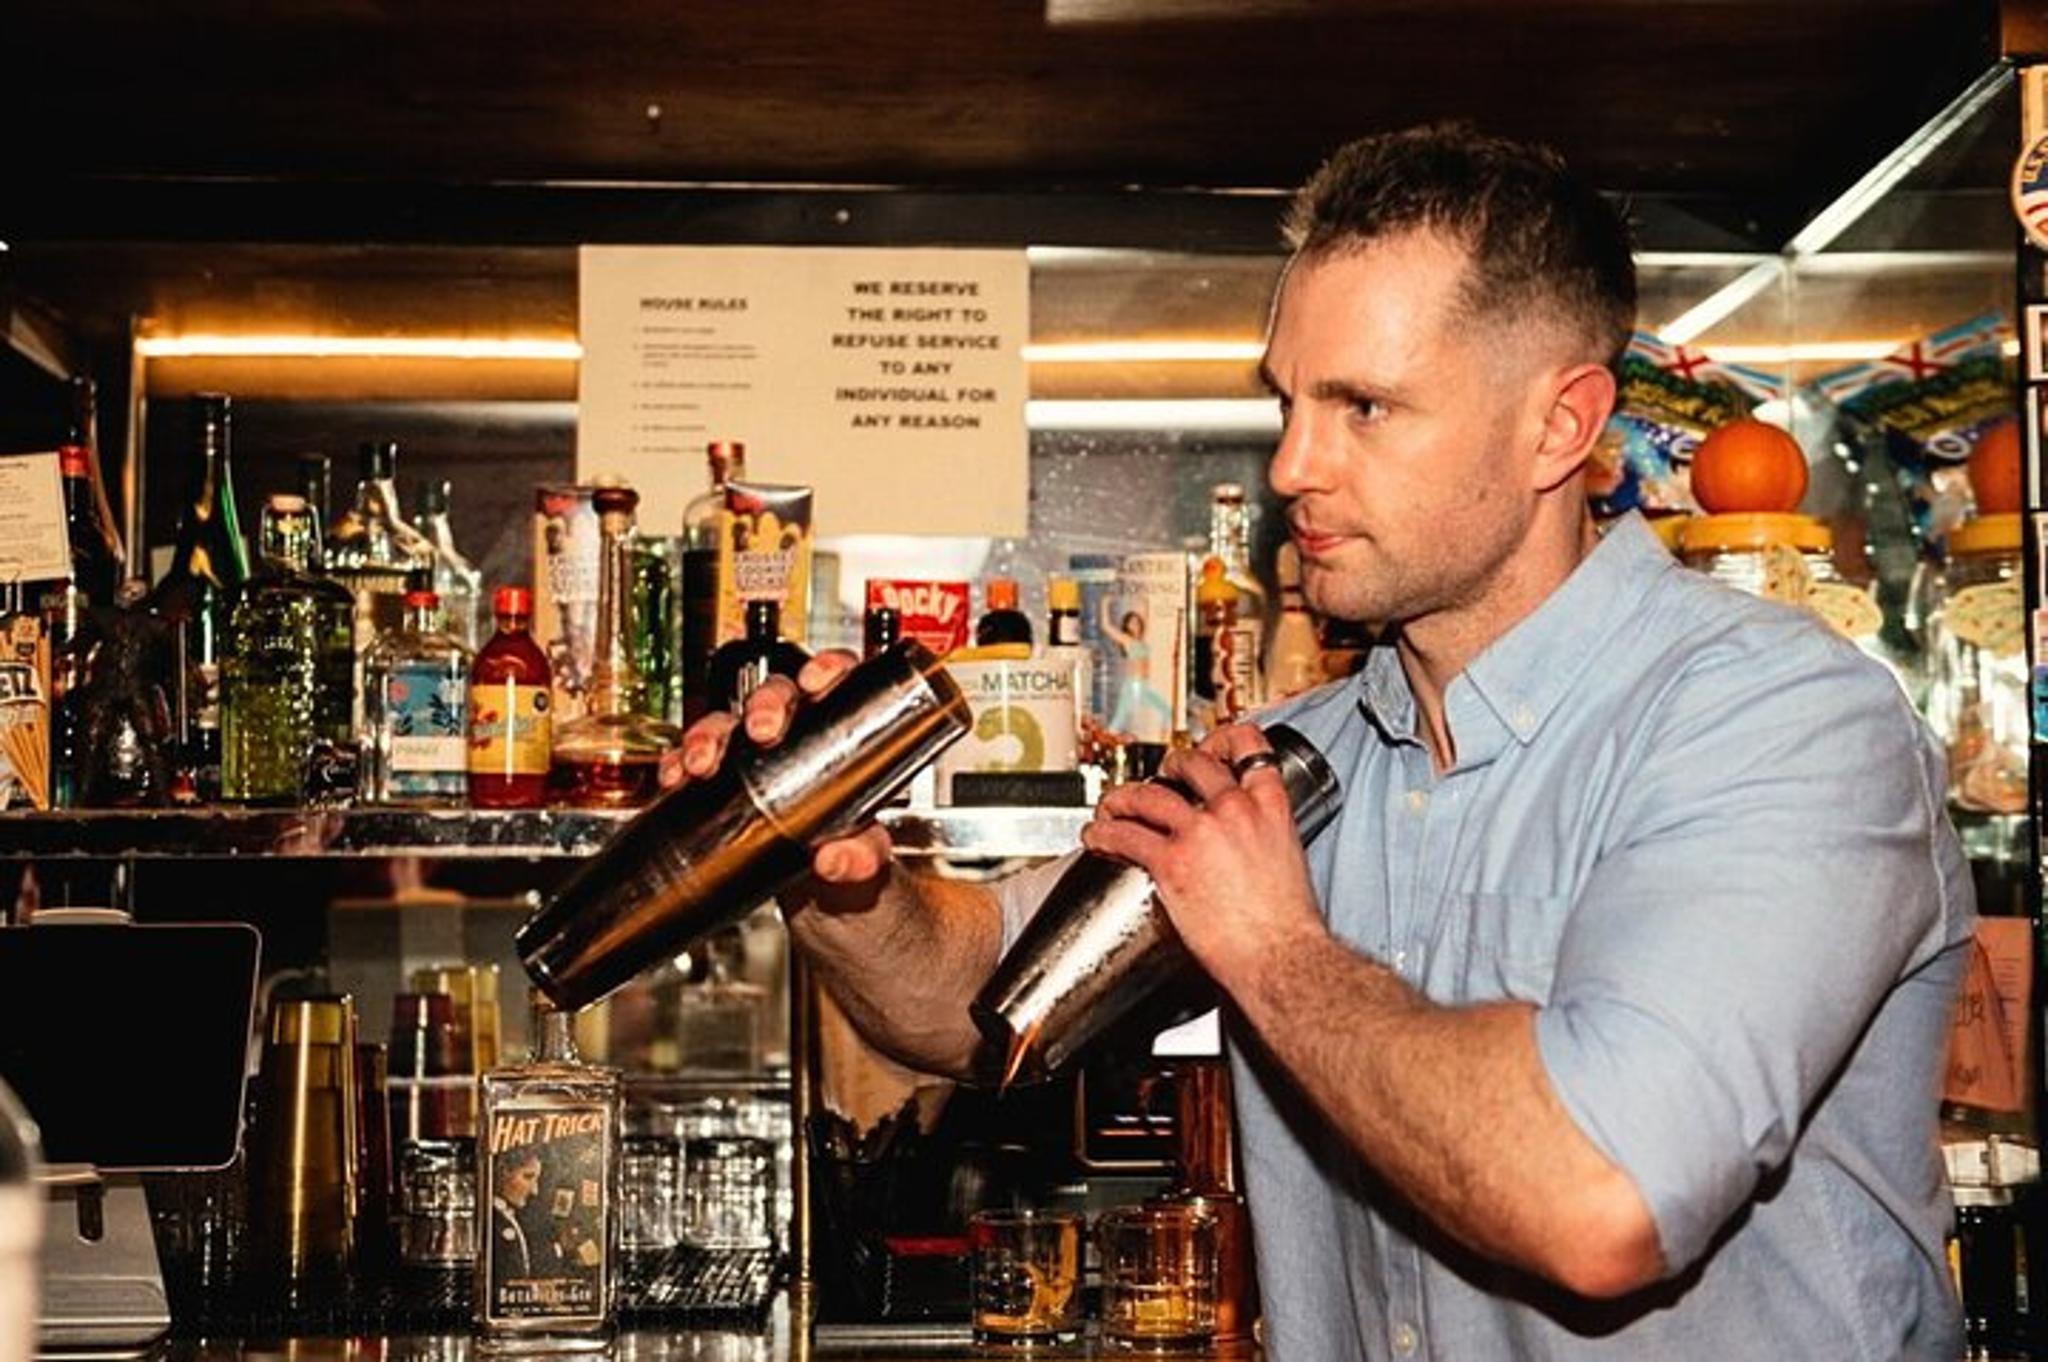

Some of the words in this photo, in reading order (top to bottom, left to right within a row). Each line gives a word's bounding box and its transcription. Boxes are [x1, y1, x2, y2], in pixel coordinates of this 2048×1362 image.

[852, 281, 882, 297] WE
[889, 281, 979, 297] RESERVE
[640, 298, 692, 312] HOUSE
[698, 298, 748, 312] RULES
[847, 307, 885, 322] THE
[891, 307, 953, 323] RIGHT
[961, 307, 987, 323] TO
[832, 334, 908, 350] REFUSE
[917, 334, 999, 351] SERVICE
[879, 361, 906, 376] TO
[911, 361, 953, 376] ANY
[835, 387, 950, 403] INDIVIDUAL
[957, 387, 997, 403] FOR
[851, 414, 892, 430] ANY
[898, 414, 982, 430] REASON
[489, 1116, 541, 1155] HAT
[543, 1113, 602, 1145] TRICK
